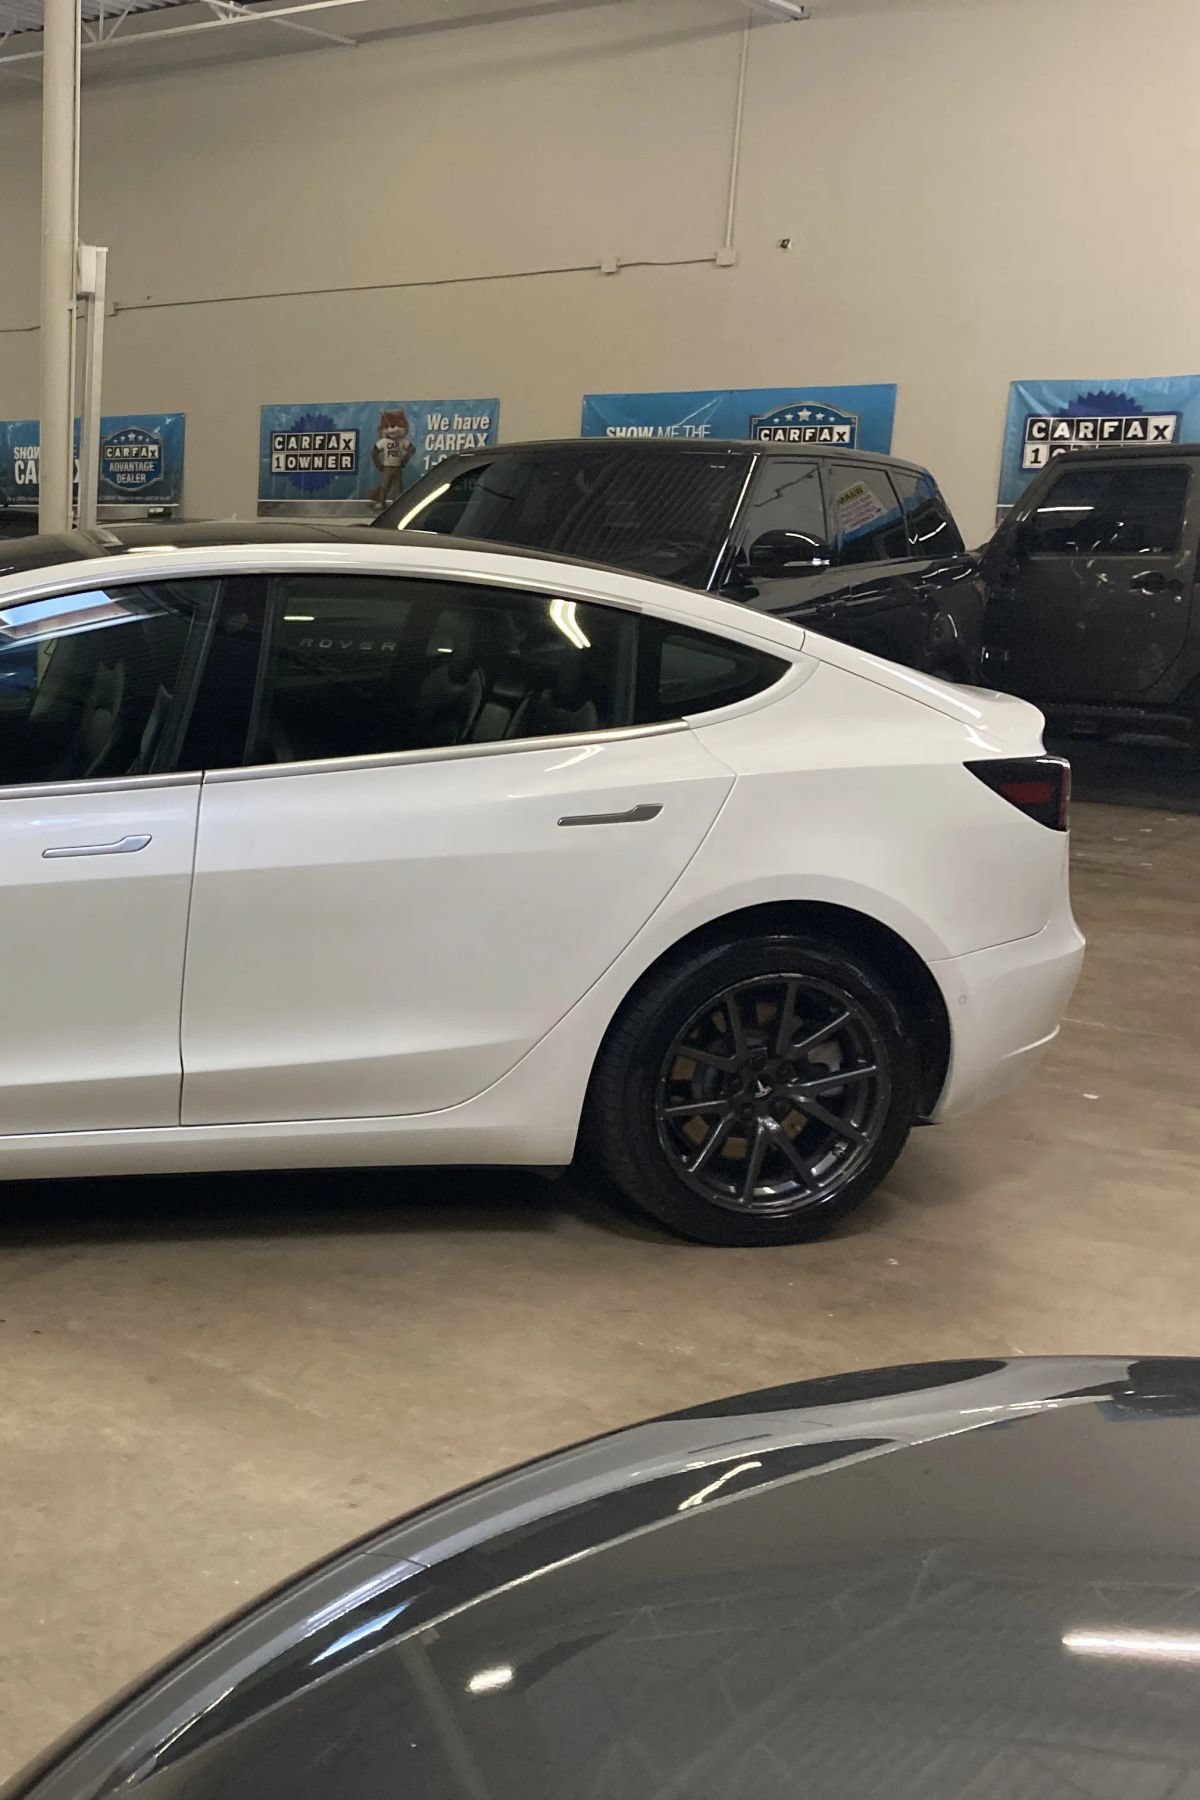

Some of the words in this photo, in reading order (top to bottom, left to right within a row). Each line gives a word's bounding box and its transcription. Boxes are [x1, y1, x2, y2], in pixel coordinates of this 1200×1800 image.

[427, 414, 449, 431] We
[453, 413, 490, 430] have
[606, 426, 654, 438] SHOW
[760, 428, 846, 442] CARFAX
[1031, 420, 1170, 440] CARFAX
[274, 432, 355, 451] CARFAX
[424, 432, 488, 451] CARFAX
[106, 446, 159, 458] CARFAX
[109, 461, 155, 472] ADVANTAGE
[274, 456, 282, 469] 1
[287, 455, 352, 469] OWNER
[116, 473, 147, 484] DEALER
[300, 638, 397, 652] ROVER
